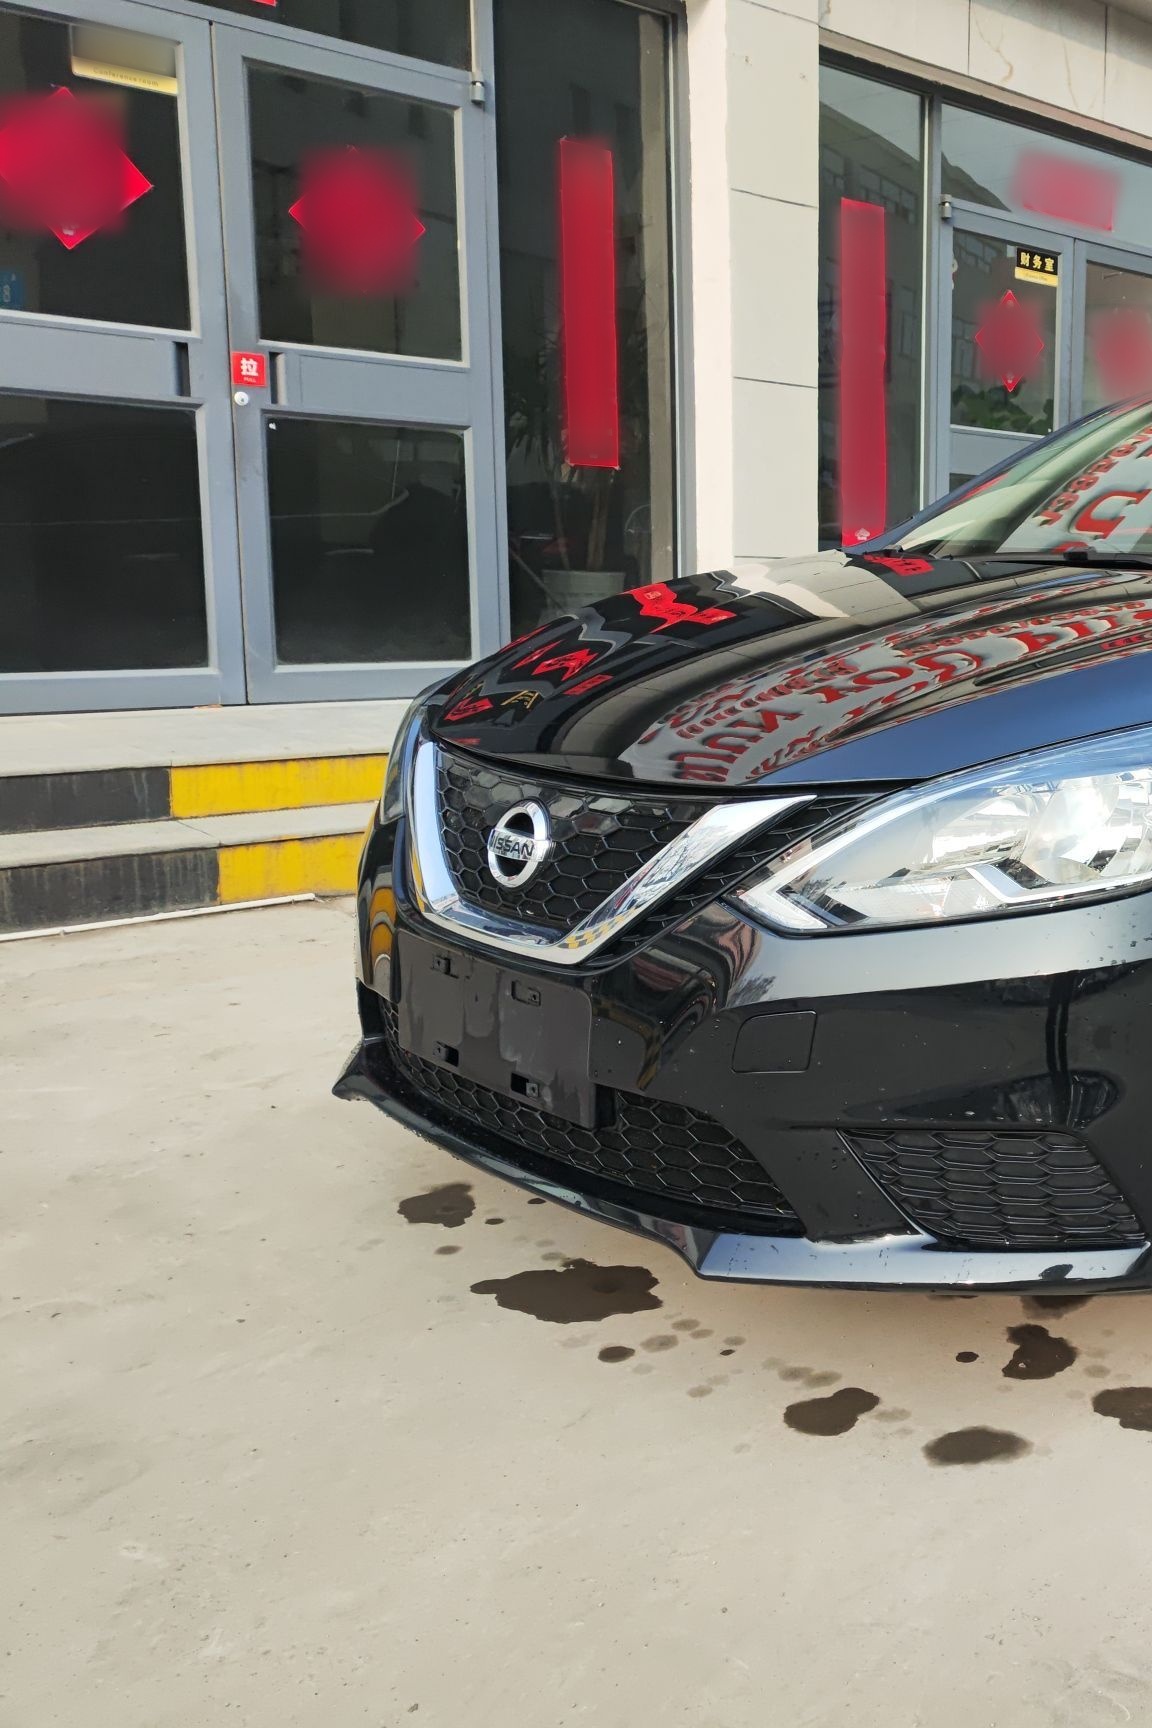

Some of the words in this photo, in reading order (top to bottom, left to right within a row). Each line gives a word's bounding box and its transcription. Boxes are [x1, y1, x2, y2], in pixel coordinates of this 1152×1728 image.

[1020, 251, 1055, 272] 财务室
[240, 357, 258, 376] 拉
